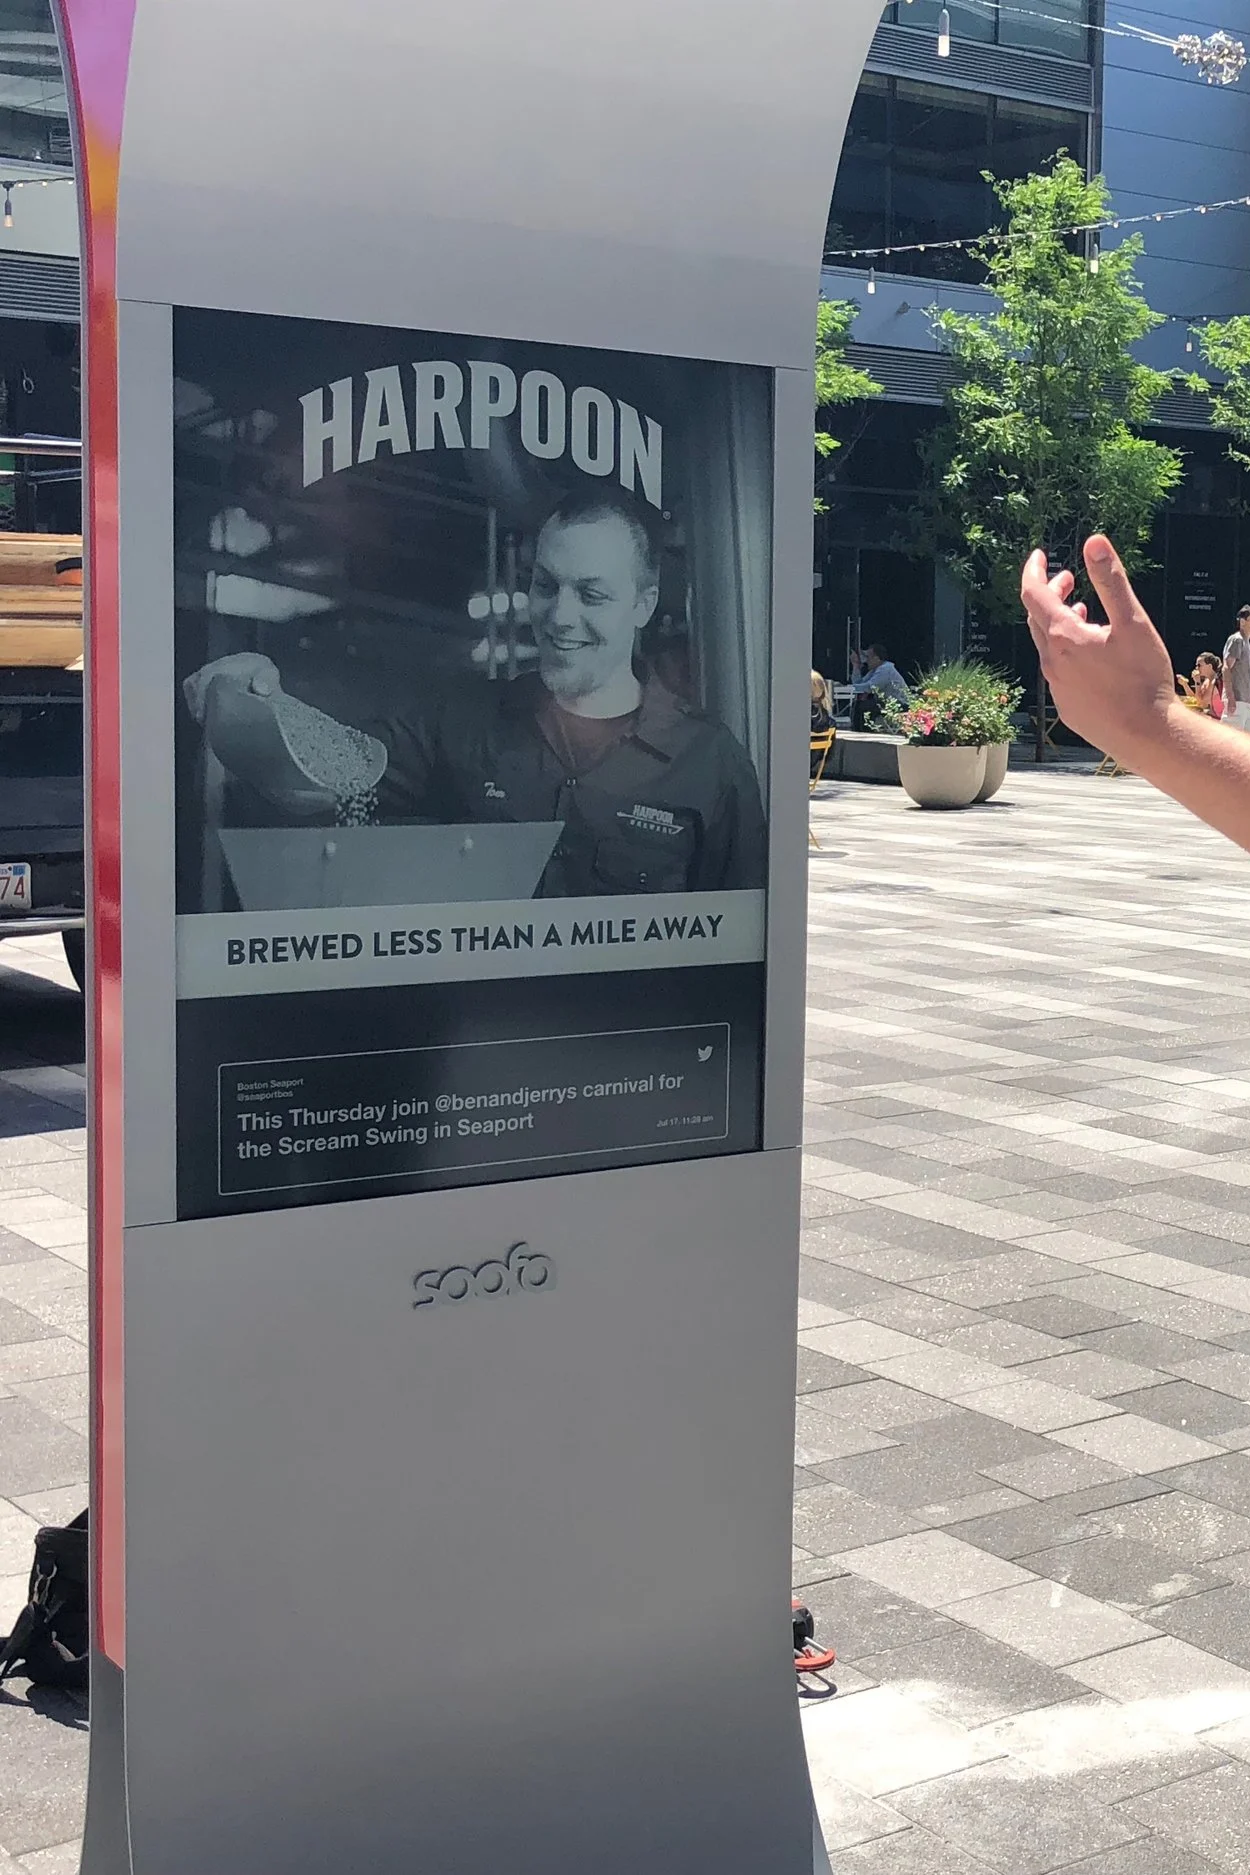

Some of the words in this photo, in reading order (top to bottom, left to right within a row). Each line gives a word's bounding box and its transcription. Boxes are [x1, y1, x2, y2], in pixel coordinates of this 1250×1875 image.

[298, 360, 663, 511] HARPOON
[633, 804, 674, 825] HARPOON
[227, 934, 363, 966] BREWED
[373, 929, 442, 958] LESS
[451, 924, 534, 953] THAN
[541, 921, 562, 948] A
[571, 917, 637, 946] MILE
[643, 914, 724, 942] AWAY
[236, 1081, 269, 1091] Boston
[269, 1077, 304, 1089] Seaport
[237, 1111, 283, 1132] This
[288, 1102, 387, 1128] Thursday
[391, 1099, 430, 1121] join
[434, 1086, 578, 1113] @benandjerrys
[582, 1074, 654, 1098] carnival
[658, 1073, 685, 1091] for
[237, 1141, 273, 1160] the
[278, 1132, 360, 1156] Scream
[364, 1124, 429, 1147] Swing
[433, 1121, 451, 1139] in
[456, 1112, 535, 1137] Seaport
